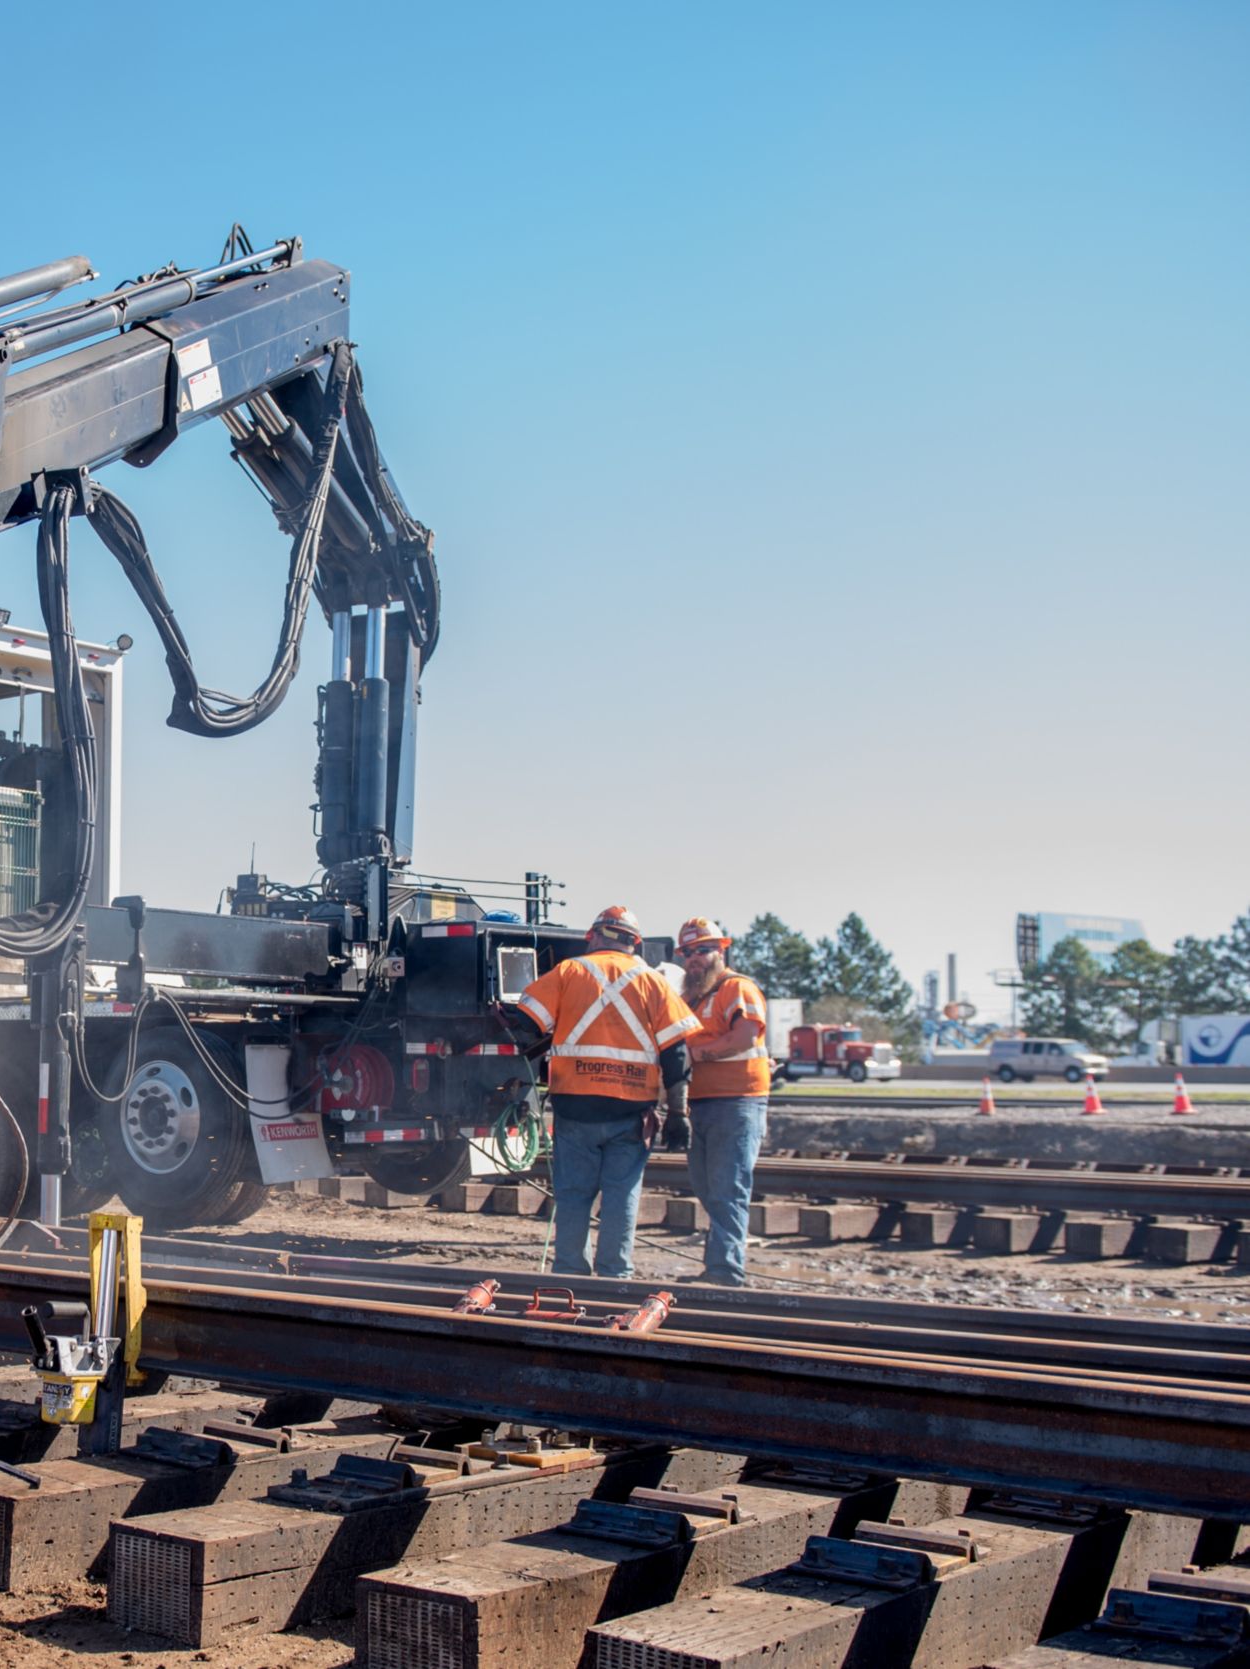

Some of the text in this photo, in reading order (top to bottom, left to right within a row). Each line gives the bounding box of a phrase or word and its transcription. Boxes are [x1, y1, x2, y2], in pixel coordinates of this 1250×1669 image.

[576, 1060, 647, 1077] Progress Rail
[270, 1123, 317, 1138] KENWORTH
